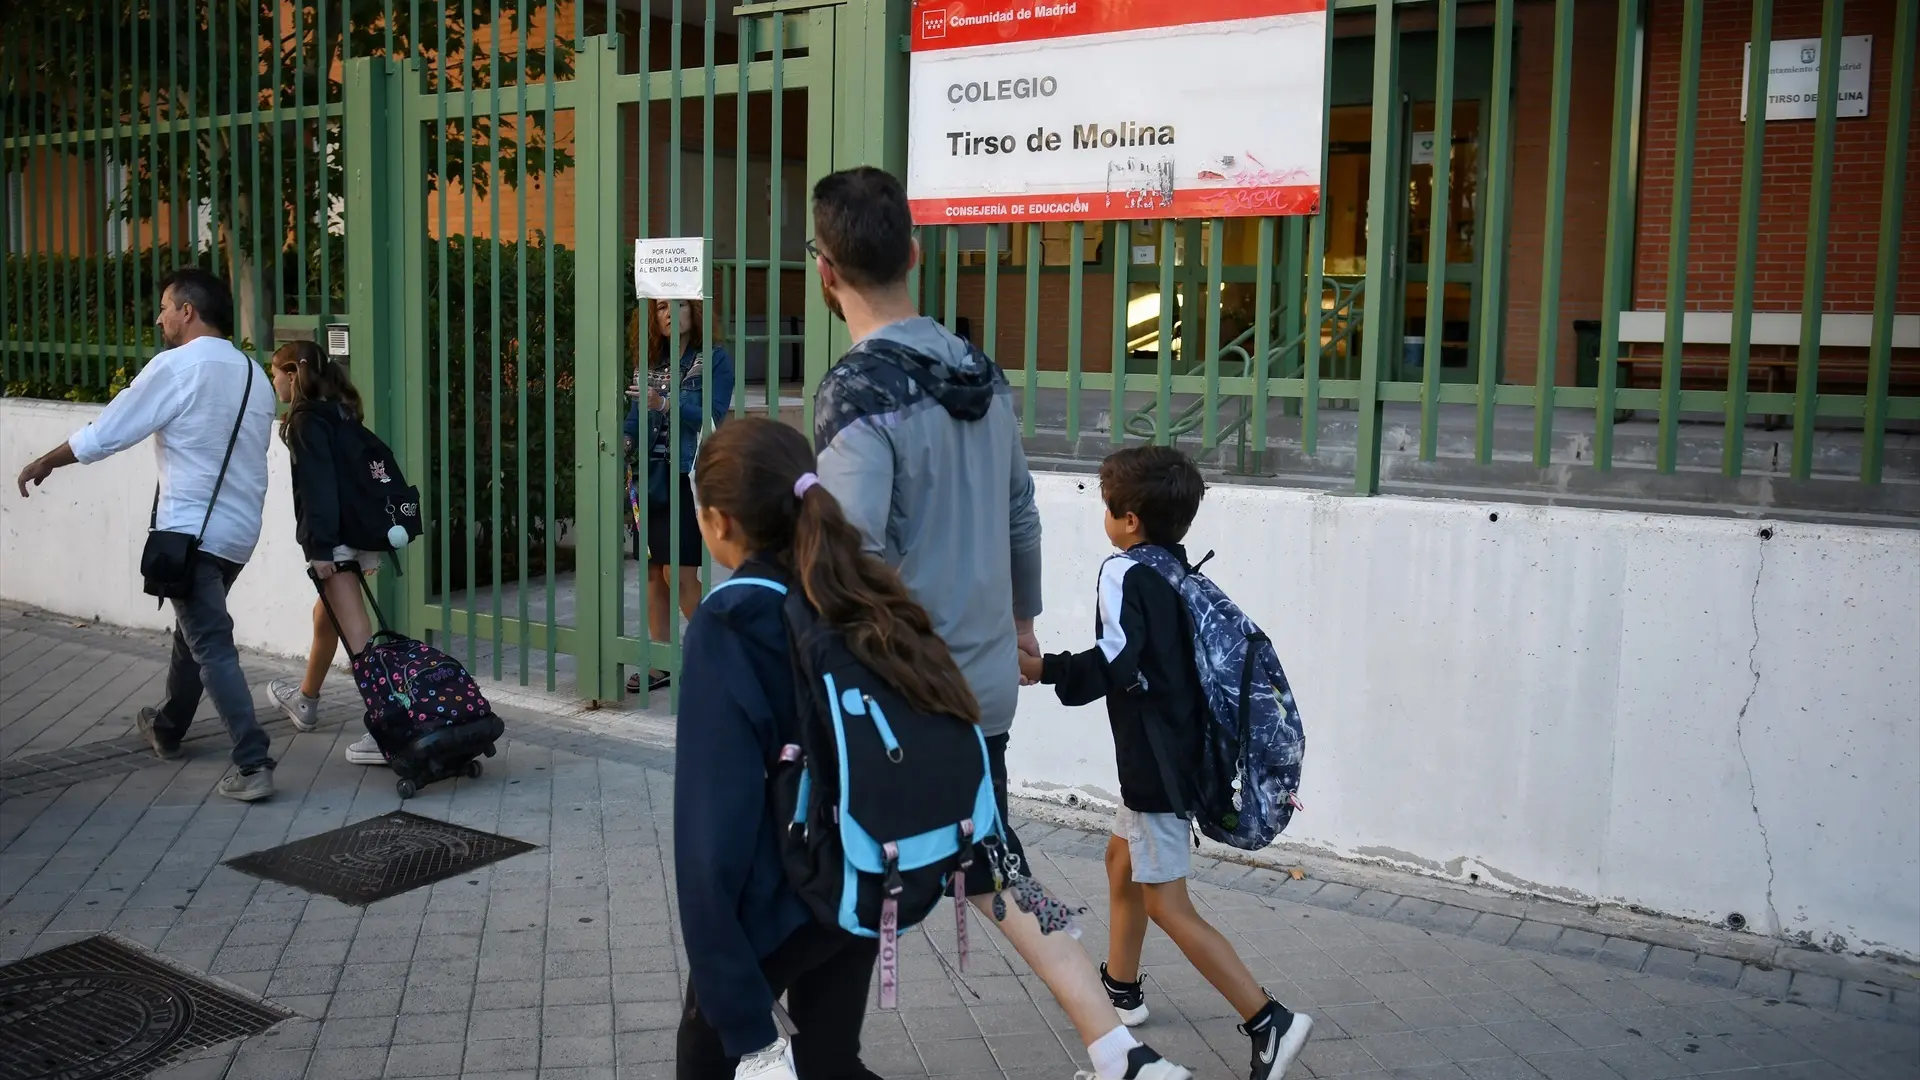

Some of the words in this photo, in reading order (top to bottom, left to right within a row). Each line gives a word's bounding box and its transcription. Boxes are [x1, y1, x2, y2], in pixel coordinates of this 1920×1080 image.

[950, 9, 1014, 27] Comunidad
[1017, 8, 1032, 20] de
[1034, 2, 1077, 18] Madrid
[947, 75, 1058, 104] COLEGIO
[1768, 94, 1800, 103] TIRSO
[1804, 93, 1818, 102] DE
[1838, 91, 1863, 101] LINA
[946, 131, 1017, 156] Tirso
[1026, 126, 1062, 152] de
[1073, 120, 1175, 150] Molina
[945, 202, 1008, 217] CONSEJERÍA
[1011, 203, 1025, 215] DE
